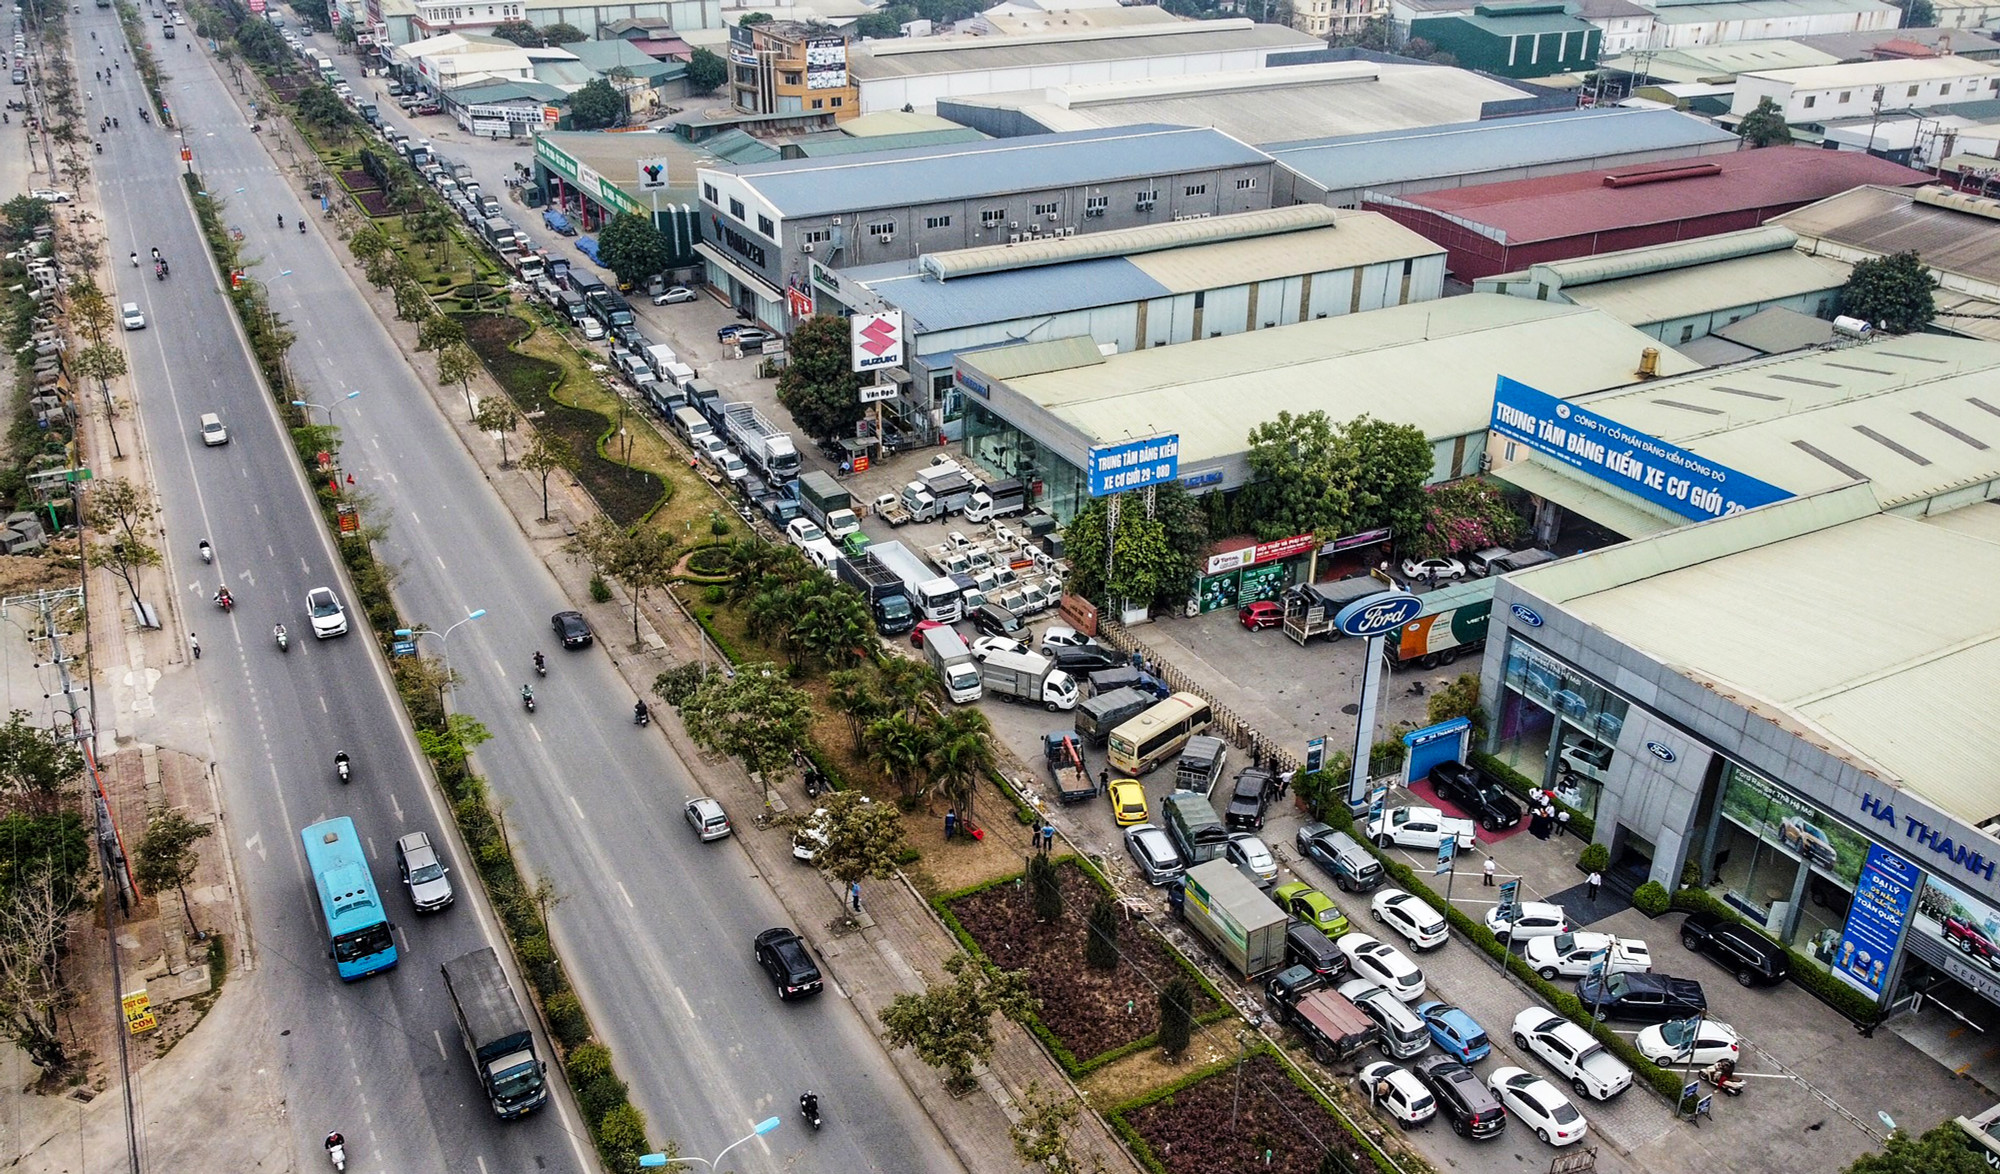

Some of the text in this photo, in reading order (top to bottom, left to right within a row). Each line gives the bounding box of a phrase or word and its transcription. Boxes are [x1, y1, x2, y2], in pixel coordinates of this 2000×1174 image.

[860, 355, 897, 367] SUZUKI
[1495, 401, 1536, 434] TRUNG
[1538, 420, 1564, 448] TÂM
[1567, 433, 1605, 465] ĐĂNG
[1605, 449, 1644, 481] KIỂM
[1643, 466, 1666, 491] XE
[1666, 476, 1691, 501] CƠ
[1690, 487, 1724, 516] GIỚI
[1573, 414, 1597, 430] CÔNG
[1598, 423, 1608, 433] TY
[1641, 441, 1666, 458] ĐĂNG
[1684, 460, 1711, 477] ĐÔNG
[1711, 471, 1726, 483] ĐÔ
[1098, 454, 1122, 471] TRUNG
[1122, 449, 1138, 466] TÂM
[1103, 475, 1114, 490] XE
[1141, 468, 1150, 481] 29
[1358, 602, 1408, 632] Ford
[1516, 607, 1535, 623] Ford
[1650, 743, 1669, 759] Ford
[1735, 768, 1752, 782] Ford
[1860, 791, 1997, 881] HA THANH
